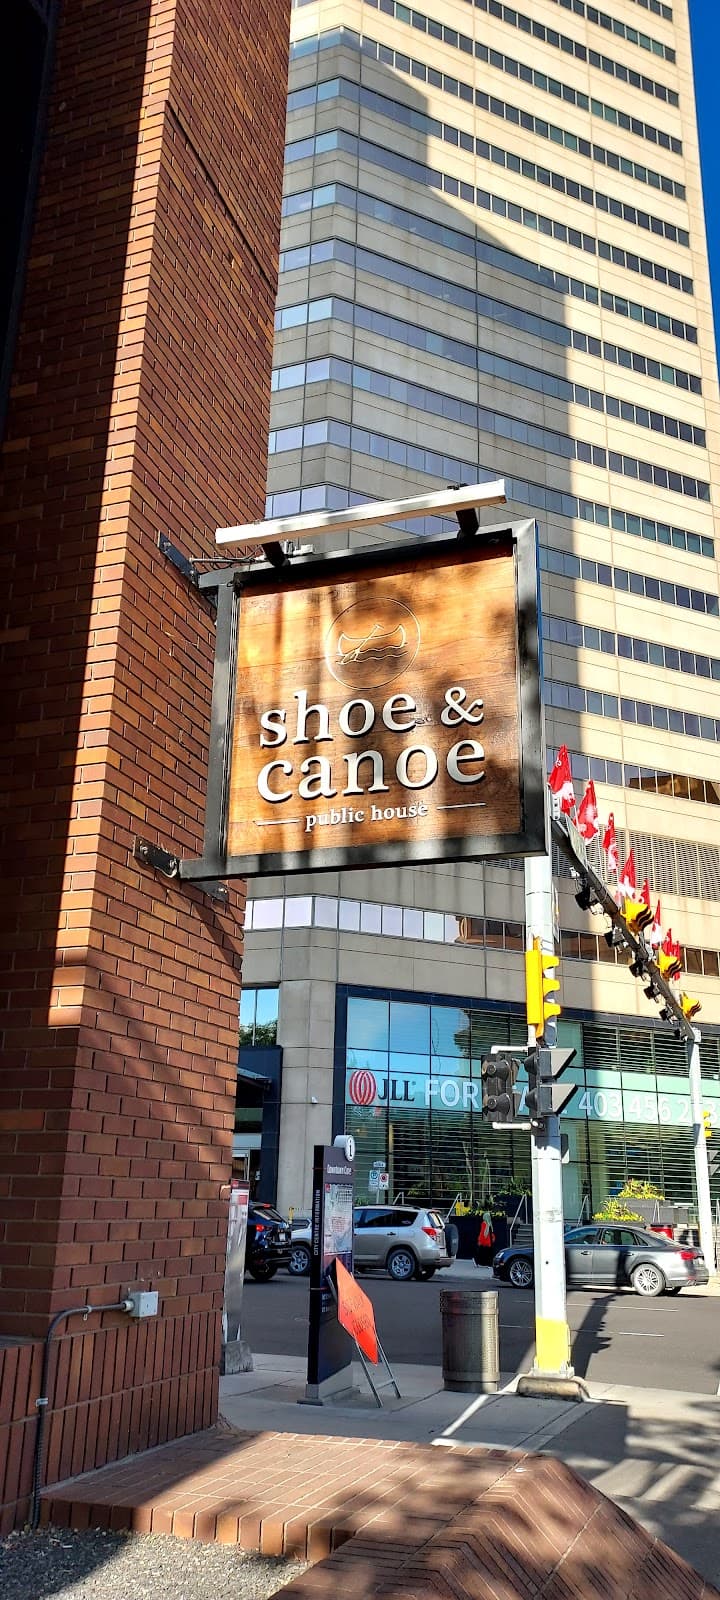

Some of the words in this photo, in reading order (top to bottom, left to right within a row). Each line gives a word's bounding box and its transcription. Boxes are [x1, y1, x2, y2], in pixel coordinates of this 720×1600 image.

[259, 689, 417, 749] shoe
[440, 686, 485, 727] &
[257, 738, 487, 804] canoe
[304, 807, 365, 832] public
[370, 803, 429, 823] house
[377, 1078, 415, 1102] JLL
[424, 1079, 481, 1109] FOR
[577, 1091, 622, 1119] 403
[628, 1096, 671, 1122] 456
